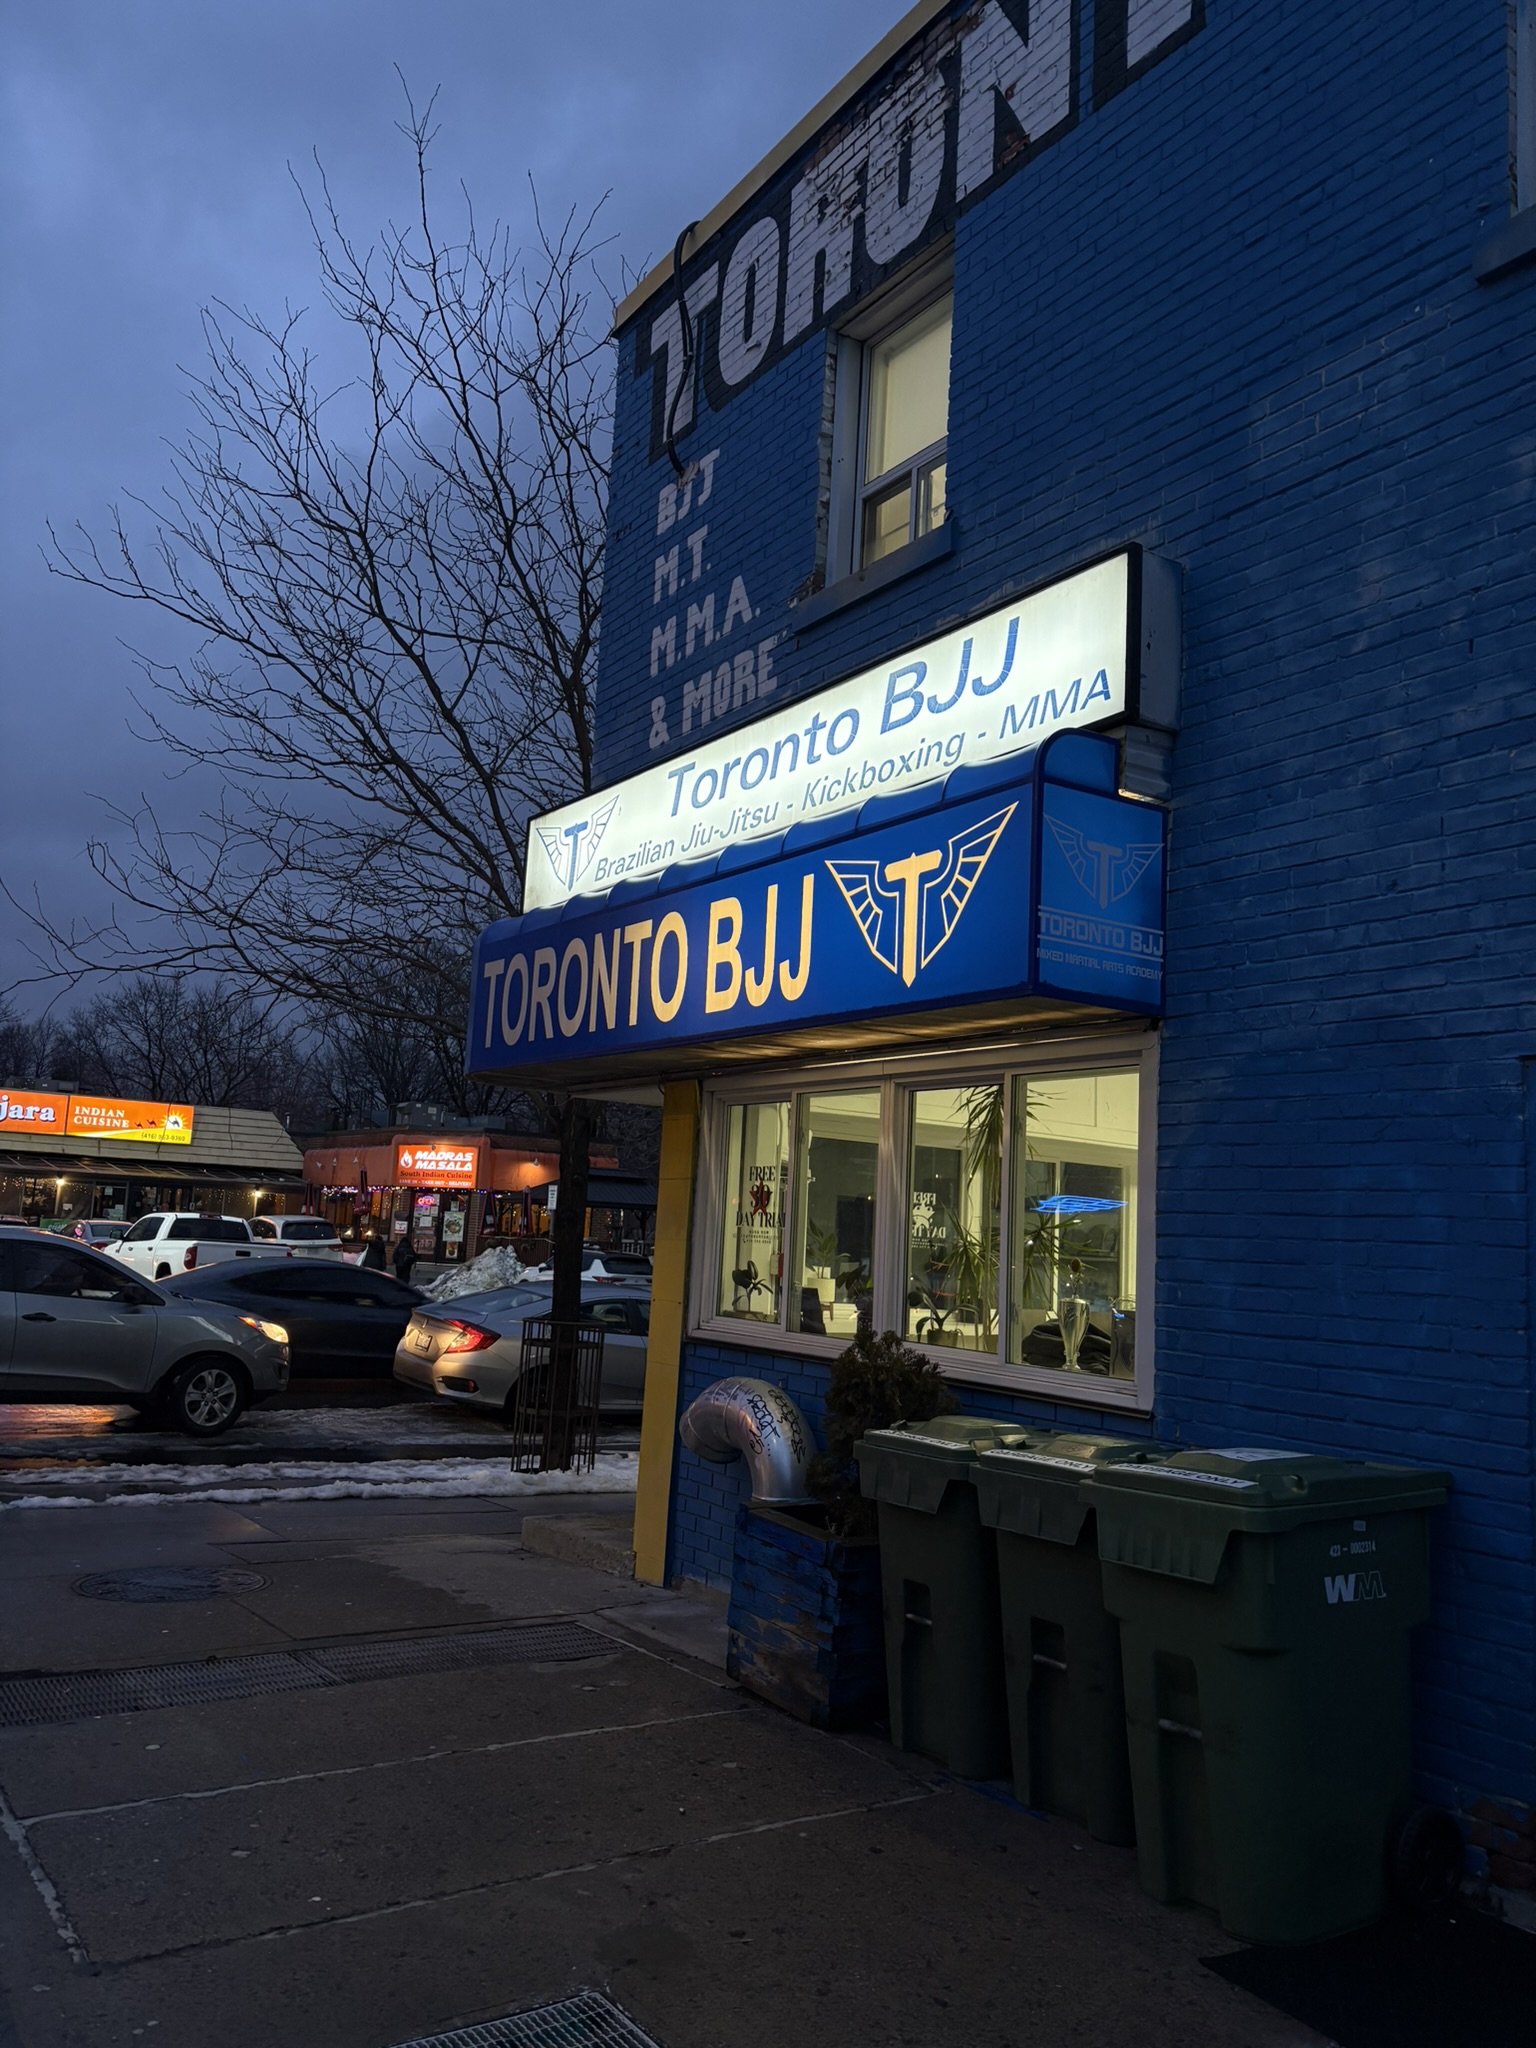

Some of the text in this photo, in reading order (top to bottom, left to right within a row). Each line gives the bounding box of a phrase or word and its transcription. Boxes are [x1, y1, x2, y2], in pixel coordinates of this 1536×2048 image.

[648, 0, 1199, 446] TORON
[657, 448, 720, 536] BJJ
[653, 524, 711, 605] M.T.
[650, 575, 760, 678] M.M.A.
[649, 636, 777, 749] & MORE
[668, 616, 1020, 817] Toronto BJJ
[594, 839, 675, 882] Brazilian
[681, 801, 780, 852] Jiu-Jitsu
[802, 731, 966, 811] Kickboxing
[1000, 668, 1111, 739] MMA
[1038, 911, 1164, 957] TORONTO BJJ
[484, 873, 815, 1048] TORONTO BJJ
[1037, 947, 1164, 981] MIXED MARTIAL ARTS ACADEMY
[0, 1094, 56, 1122] jara
[73, 1116, 130, 1128] CUISINE
[74, 1106, 126, 1118] INDIAN
[415, 1151, 474, 1162] MADRAS
[415, 1160, 473, 1171] MASALA
[422, 1171, 445, 1179] Indian
[749, 1166, 775, 1181] FREE
[418, 1197, 434, 1206] OPEN
[736, 1211, 756, 1227] DAY
[1117, 1463, 1246, 1485] GARBAGE ONLY
